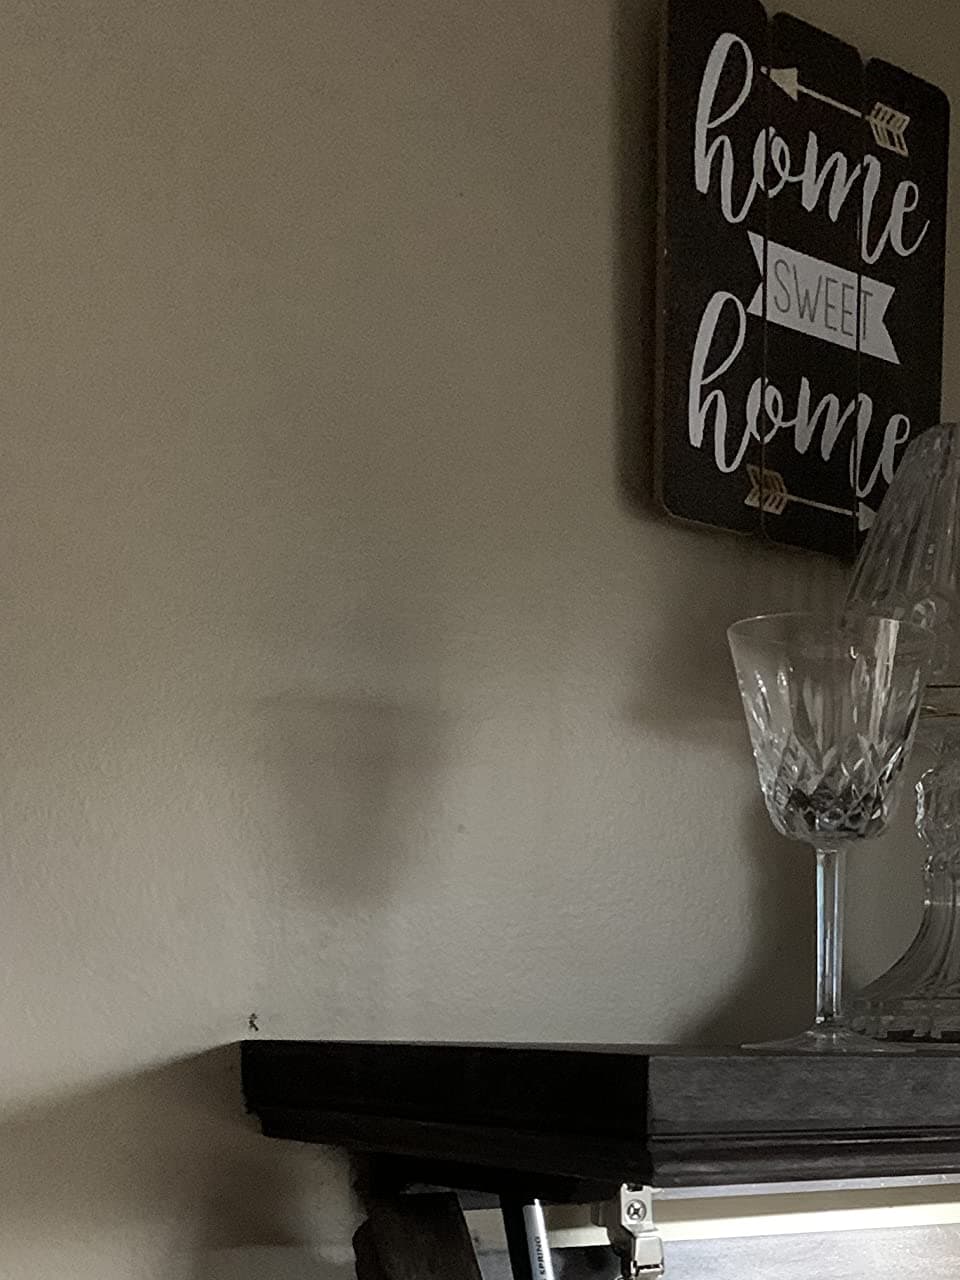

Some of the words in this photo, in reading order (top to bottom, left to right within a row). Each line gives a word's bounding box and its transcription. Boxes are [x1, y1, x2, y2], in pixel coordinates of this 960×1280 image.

[694, 32, 930, 264] home
[773, 258, 874, 341] SWEET
[688, 290, 911, 498] home
[534, 1236, 546, 1275] SPRING
